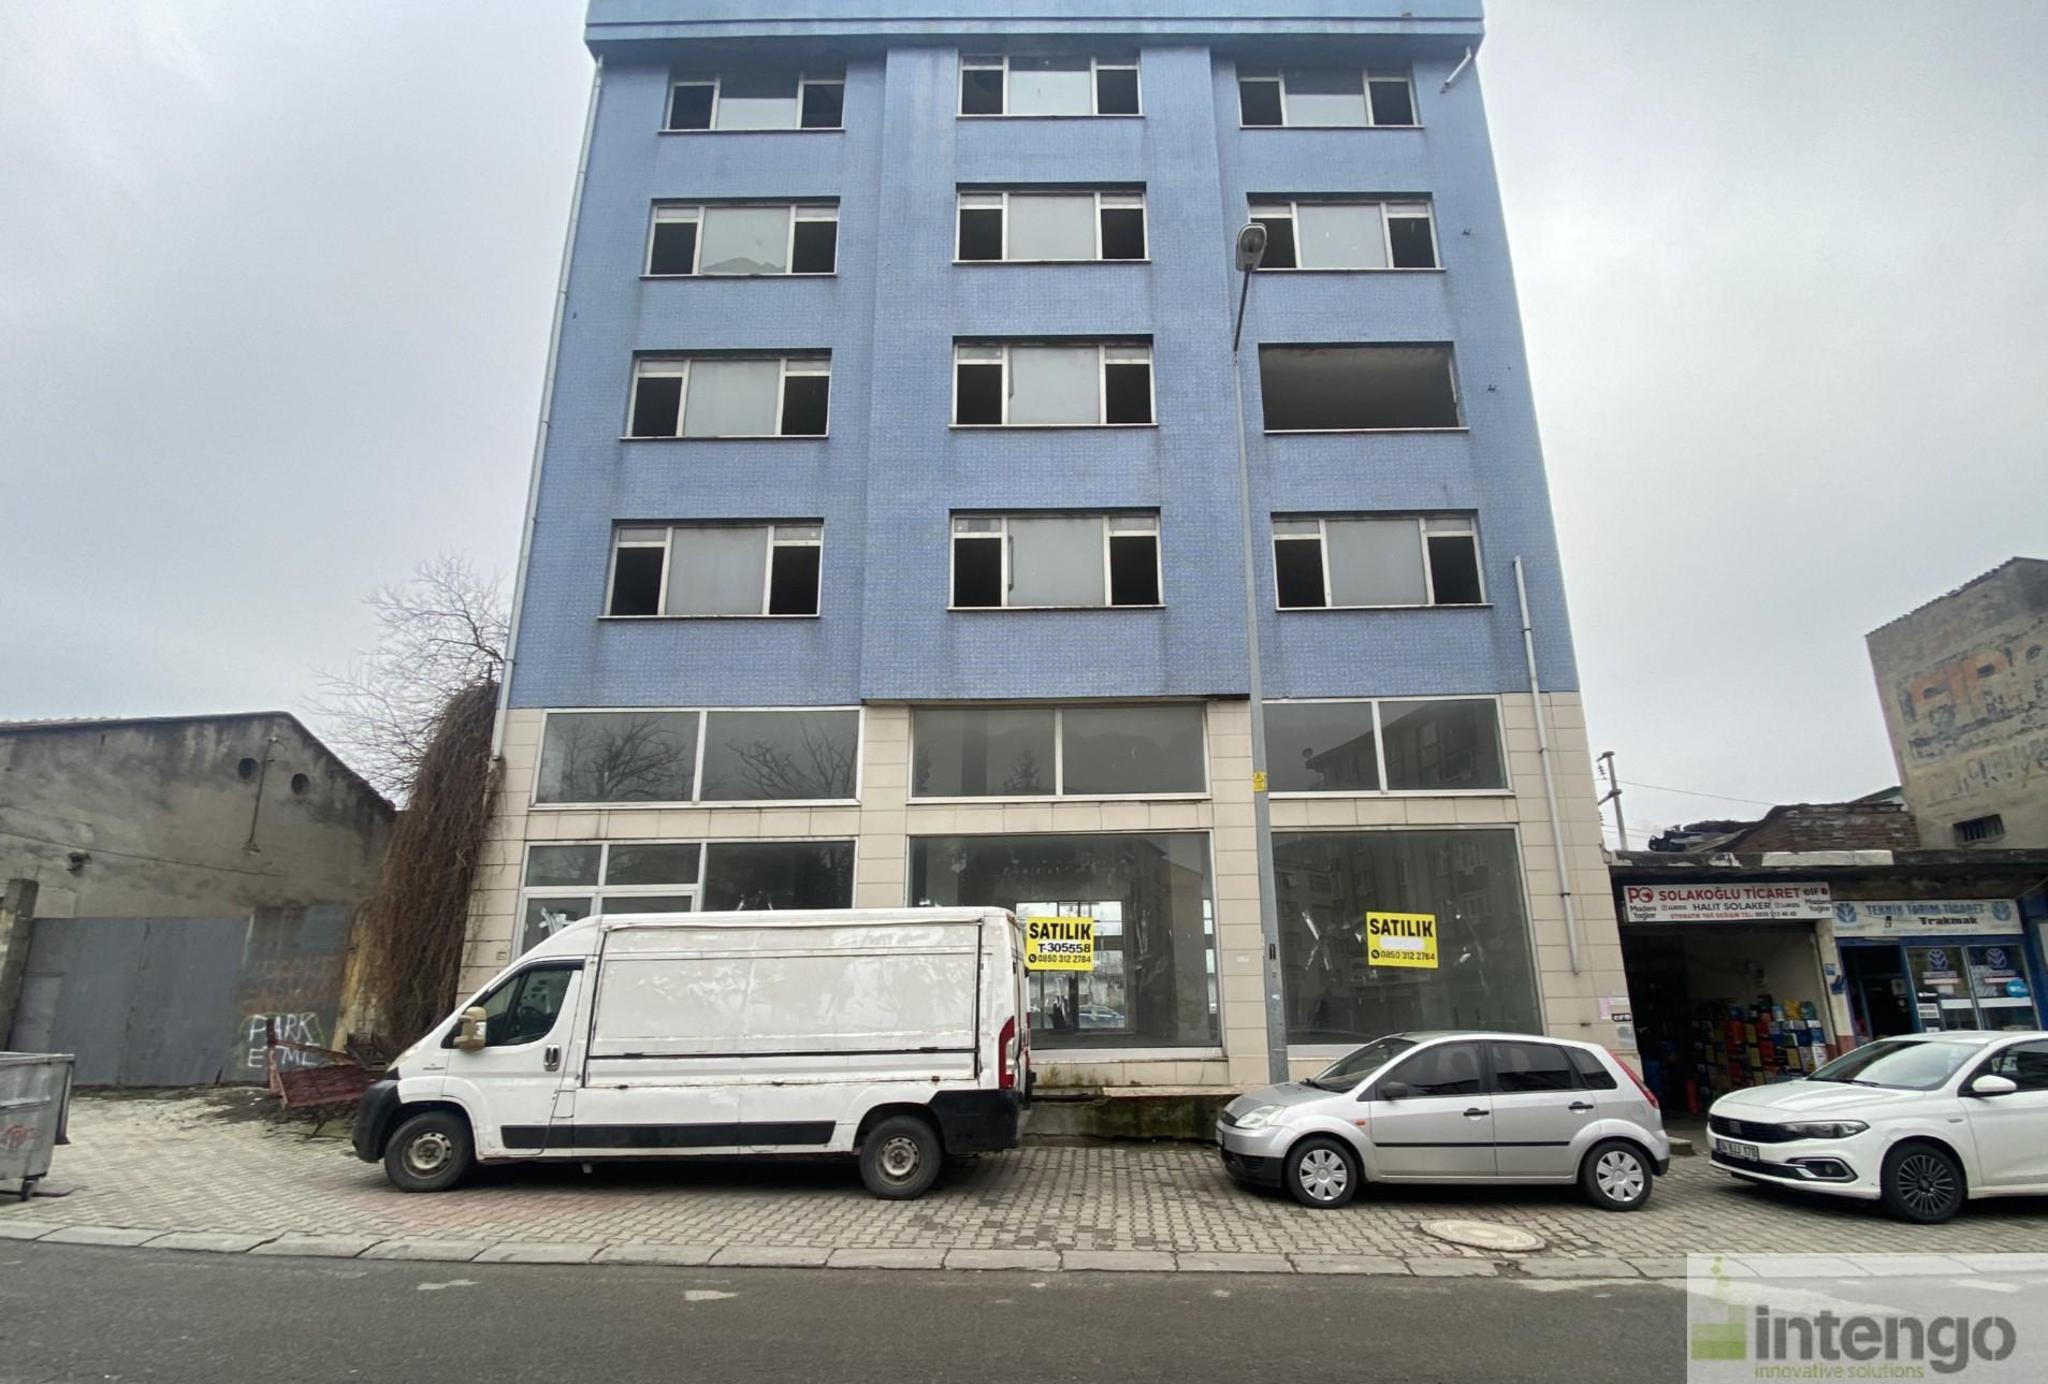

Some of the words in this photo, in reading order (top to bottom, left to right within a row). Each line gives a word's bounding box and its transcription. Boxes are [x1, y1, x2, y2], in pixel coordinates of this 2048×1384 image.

[1659, 886, 1740, 901] SOLAKOĞLU
[1743, 886, 1800, 899] TİCARET
[1723, 902, 1771, 911] SOLAKER
[1918, 915, 1978, 925] Trakmak
[1029, 922, 1091, 940] SATILIK
[1370, 918, 1433, 937] SATILIK
[1038, 942, 1091, 953] T-305558
[1038, 954, 1057, 963] 0850
[1058, 955, 1072, 963] 312
[1402, 951, 1415, 960] 312
